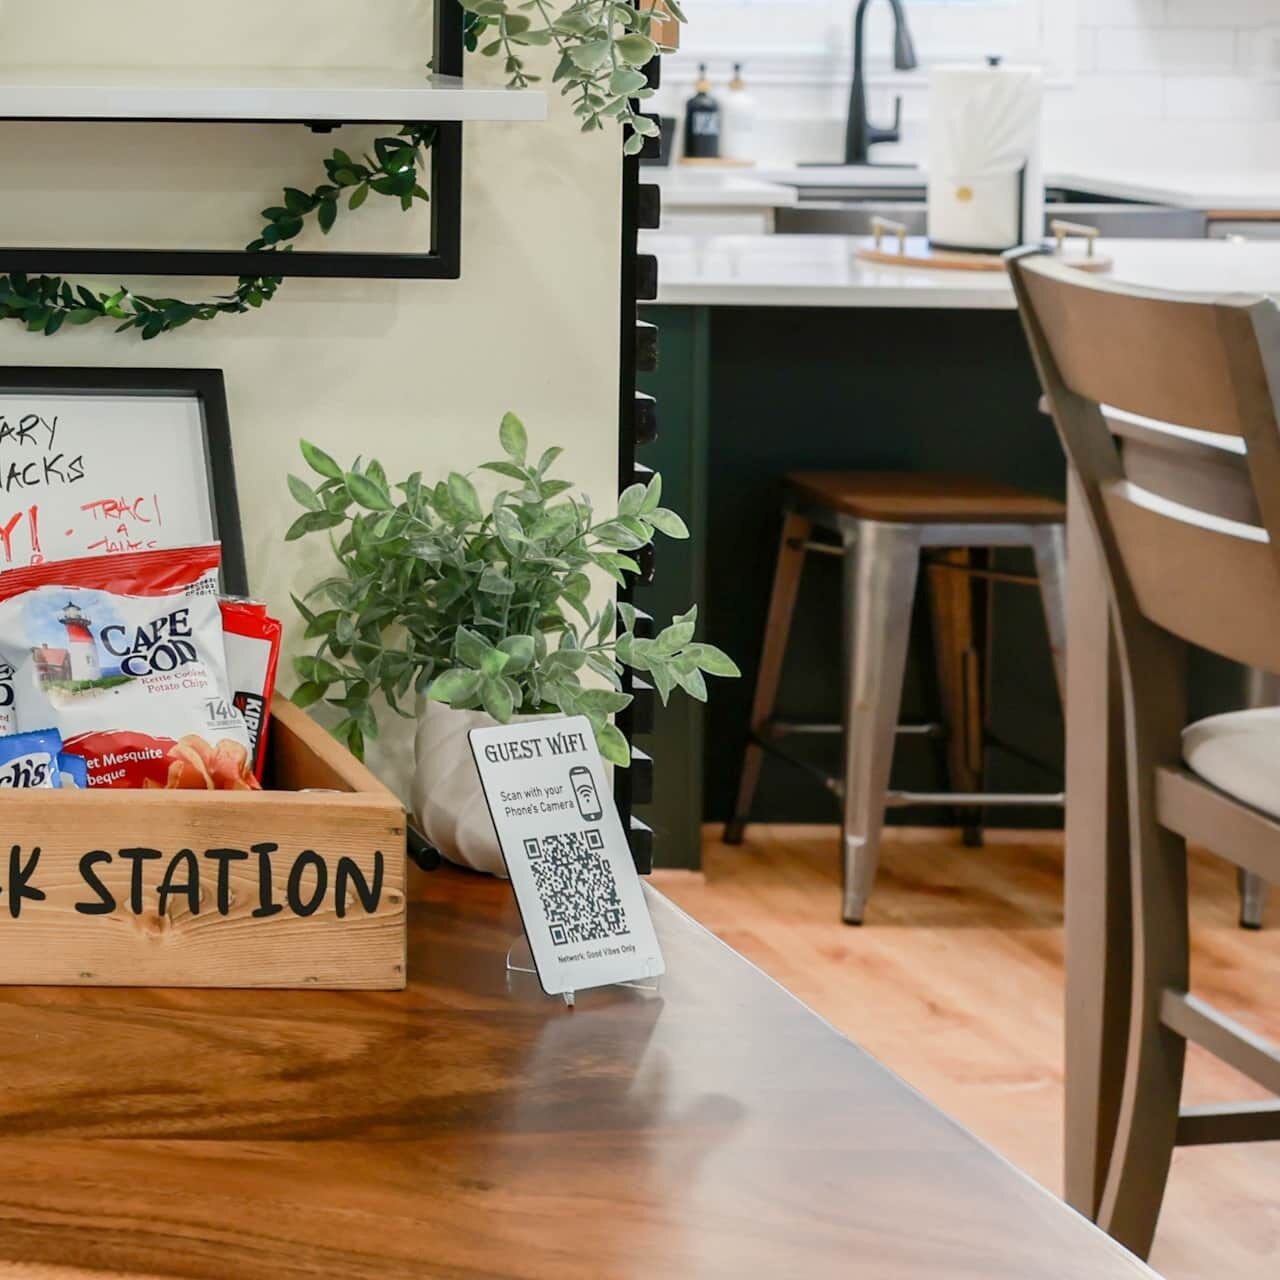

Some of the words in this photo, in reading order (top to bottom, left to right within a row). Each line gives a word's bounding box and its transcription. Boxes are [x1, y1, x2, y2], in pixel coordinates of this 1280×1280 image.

[100, 608, 193, 657] CAPE
[121, 639, 199, 677] COD
[146, 683, 181, 694] Potato
[103, 748, 164, 766] Mesquite
[484, 738, 543, 763] GUEST
[87, 767, 126, 786] beque
[500, 791, 523, 802] Scan
[524, 786, 543, 798] with
[544, 785, 563, 799] your
[504, 804, 539, 817] Phone's
[539, 800, 575, 813] Camera
[74, 842, 385, 918] STATION
